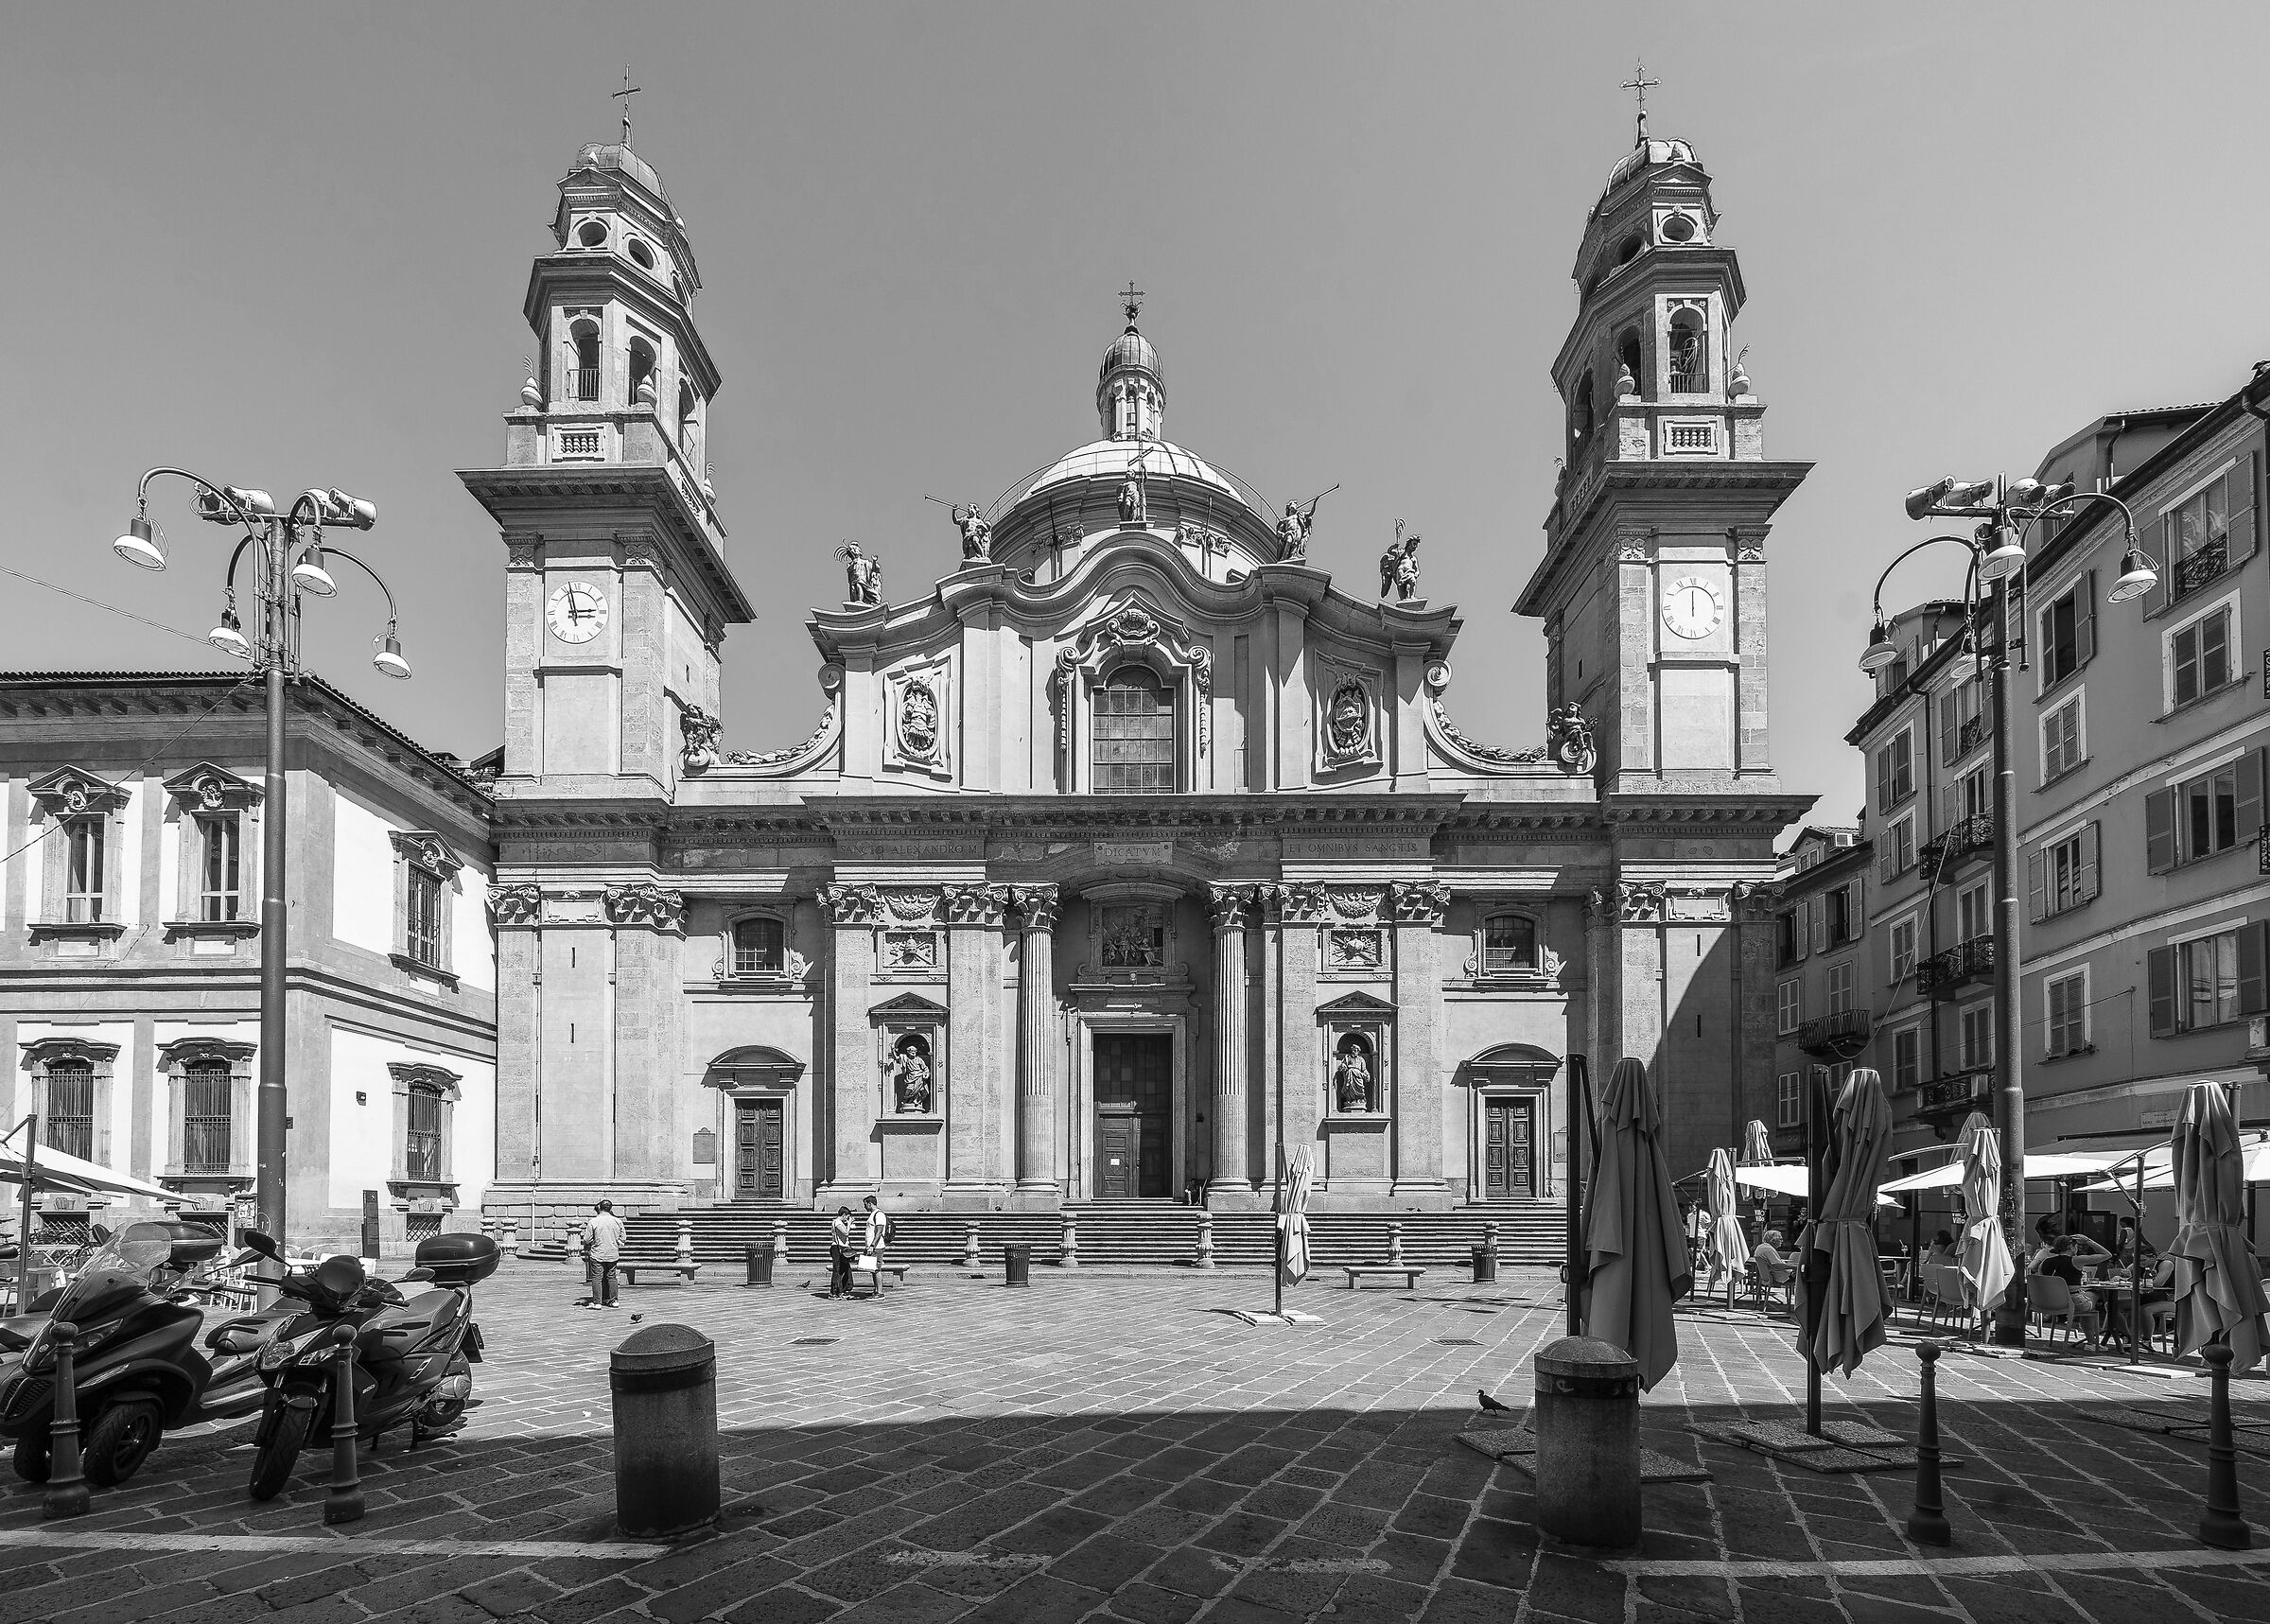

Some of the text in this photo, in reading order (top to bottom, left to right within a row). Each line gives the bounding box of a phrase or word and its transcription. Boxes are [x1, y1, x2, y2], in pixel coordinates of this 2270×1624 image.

[840, 845, 884, 854] SANCTO
[892, 845, 964, 854] ALEXANDRO
[1105, 847, 1161, 857] DICATVM
[1308, 843, 1358, 853] OMNIBVS
[1366, 843, 1417, 852] SANCTIS
